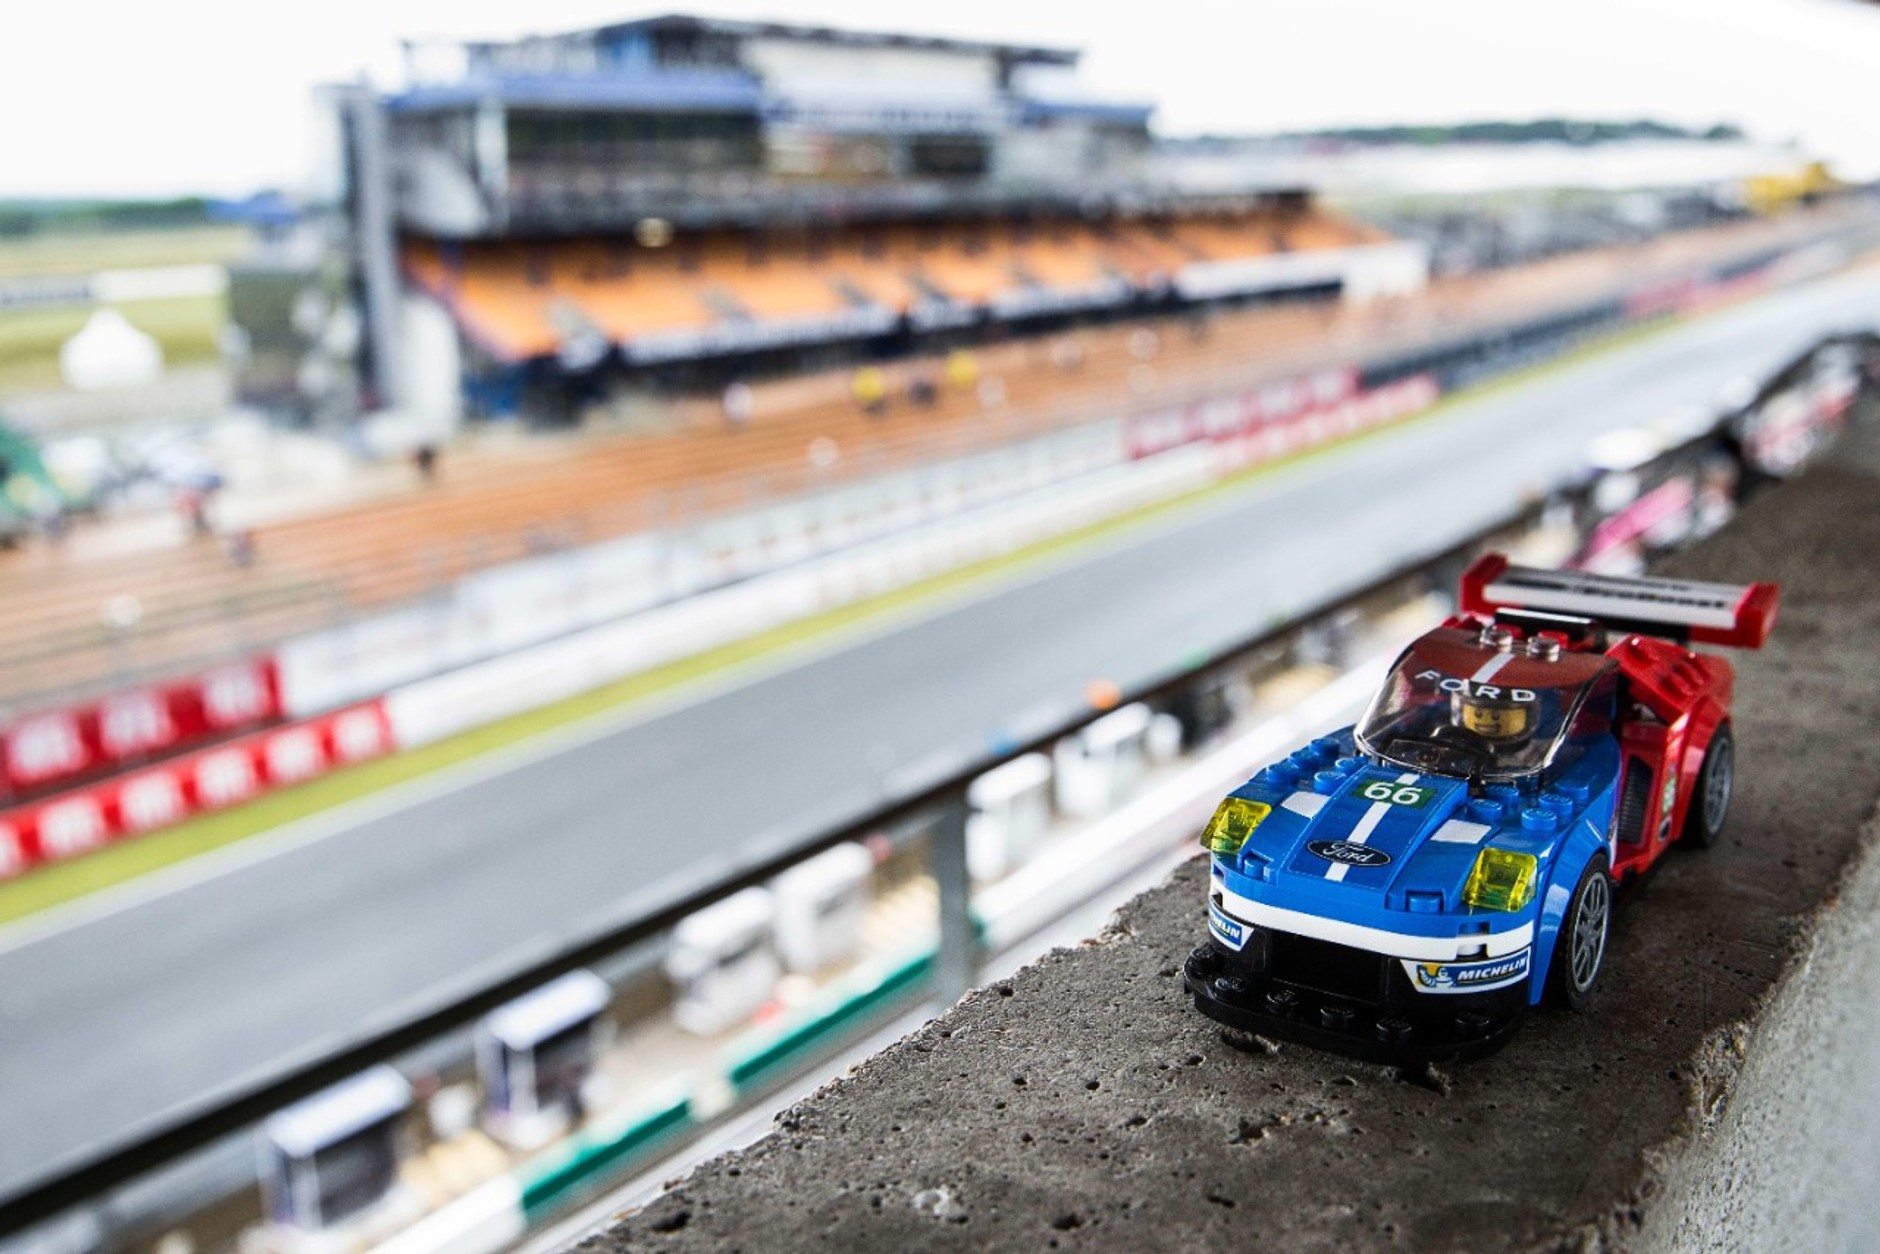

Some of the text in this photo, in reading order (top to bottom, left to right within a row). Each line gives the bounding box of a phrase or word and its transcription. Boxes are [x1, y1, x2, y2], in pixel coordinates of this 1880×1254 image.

[1414, 669, 1536, 702] FORD
[1364, 782, 1423, 805] 66
[1323, 842, 1375, 862] Ford
[1458, 957, 1527, 980] MICHELIN
